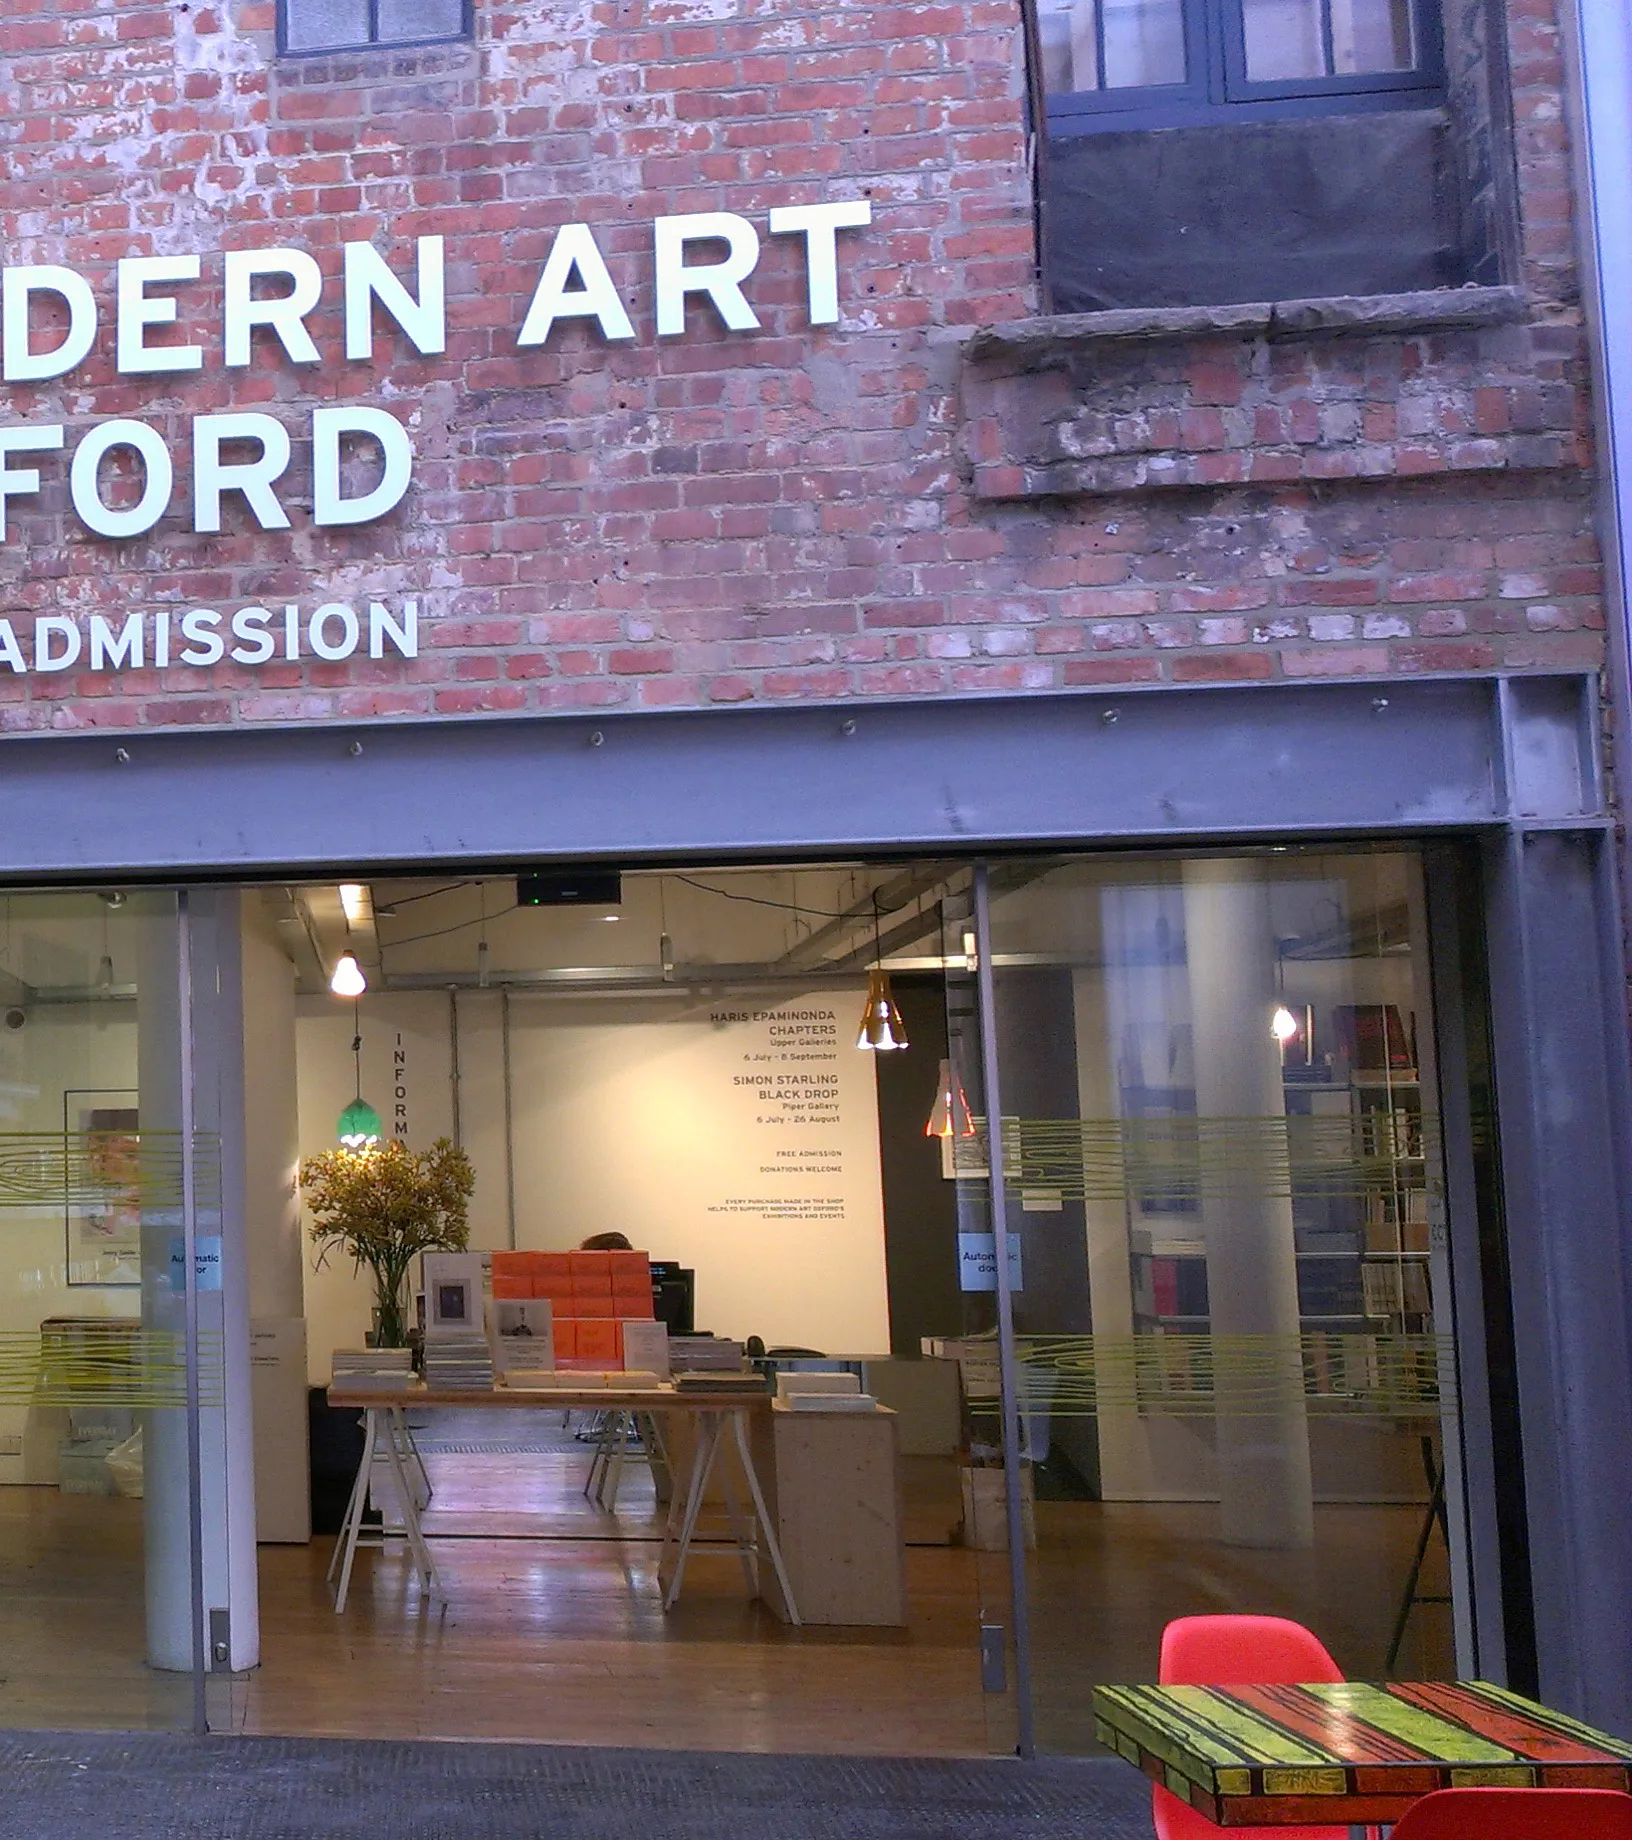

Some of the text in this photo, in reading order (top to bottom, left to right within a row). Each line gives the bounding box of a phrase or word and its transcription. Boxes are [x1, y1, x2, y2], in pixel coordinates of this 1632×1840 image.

[518, 200, 872, 345] ART
[710, 1011, 836, 1022] HARIS EPAMINONDA
[769, 1025, 837, 1036] CHAPTERS
[770, 1038, 837, 1047] Upper Galleries
[790, 1053, 837, 1061] September
[733, 1075, 839, 1086] SIMON STARLING
[393, 1033, 408, 1148] INFORM
[759, 1089, 839, 1100] BLACK DROP
[782, 1102, 840, 1111] Piper Gallery
[765, 1116, 784, 1124] July
[809, 1114, 840, 1124] August
[171, 1253, 219, 1263] Aumatic
[963, 1252, 1017, 1261] Automic
[978, 1263, 999, 1272] doo
